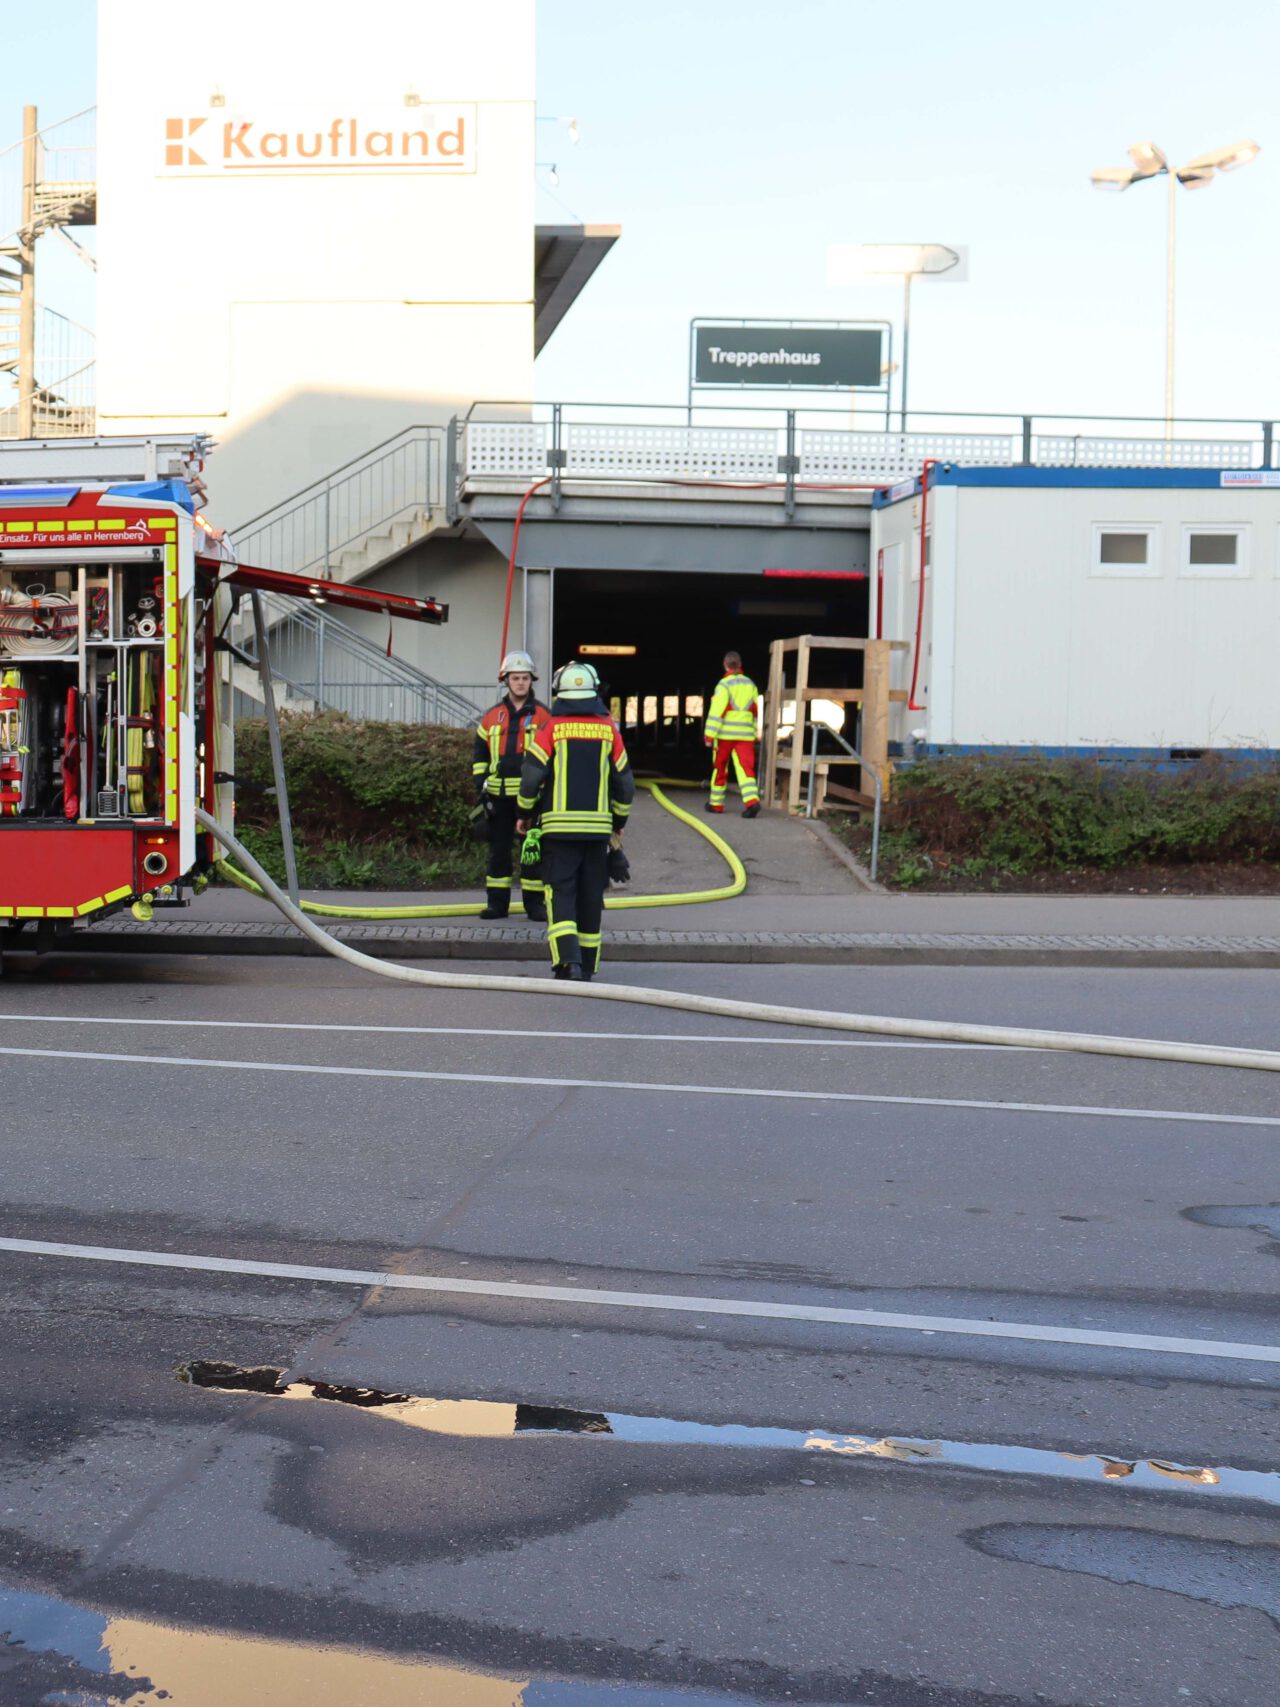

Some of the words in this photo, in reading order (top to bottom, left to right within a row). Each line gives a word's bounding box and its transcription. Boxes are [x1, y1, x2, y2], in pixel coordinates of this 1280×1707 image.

[222, 117, 465, 159] Kaufland
[708, 347, 821, 368] Treppenhaus
[0, 533, 31, 543] Einsatz.
[33, 533, 48, 542] Für
[50, 534, 65, 542] uns
[67, 533, 82, 541] alle
[83, 532, 92, 541] in
[94, 531, 144, 542] Herrenberg
[554, 722, 613, 733] FEUERWEHR
[552, 730, 615, 741] HERRENBERG
